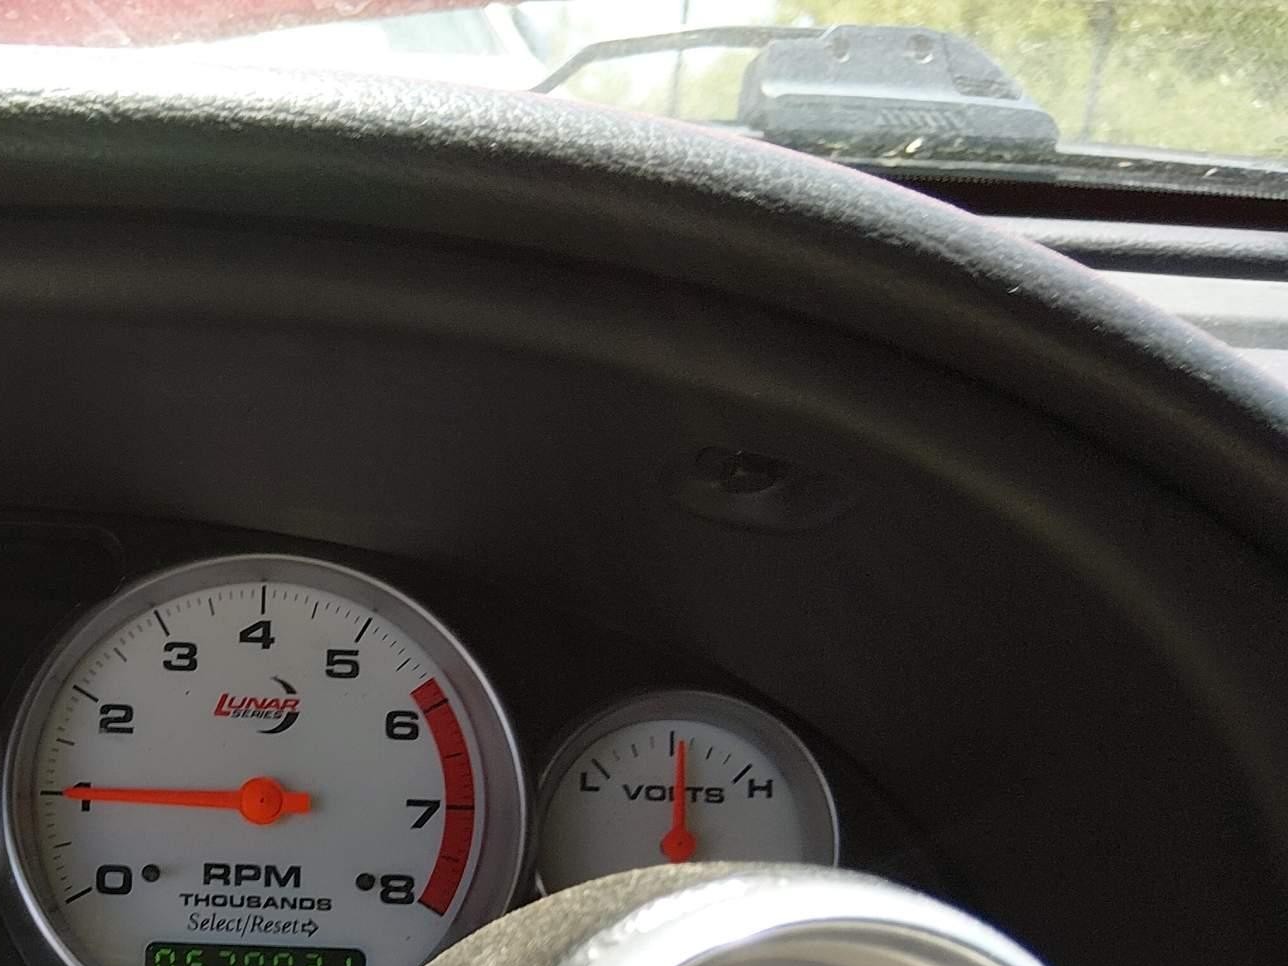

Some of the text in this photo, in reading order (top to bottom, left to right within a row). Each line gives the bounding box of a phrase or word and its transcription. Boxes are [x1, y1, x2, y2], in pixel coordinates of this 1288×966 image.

[239, 620, 275, 649] 4
[163, 642, 198, 672] 3
[325, 650, 360, 679] 5
[99, 704, 134, 734] 2
[232, 709, 284, 719] SERIES
[386, 711, 419, 740] 6
[580, 773, 600, 791] L
[748, 779, 773, 798] H
[406, 800, 441, 829] 7
[96, 865, 132, 895] 0
[203, 863, 301, 888] RPM
[379, 875, 416, 904] 8
[179, 893, 333, 911] THOUSANDS
[187, 912, 299, 939] Select/Reset
